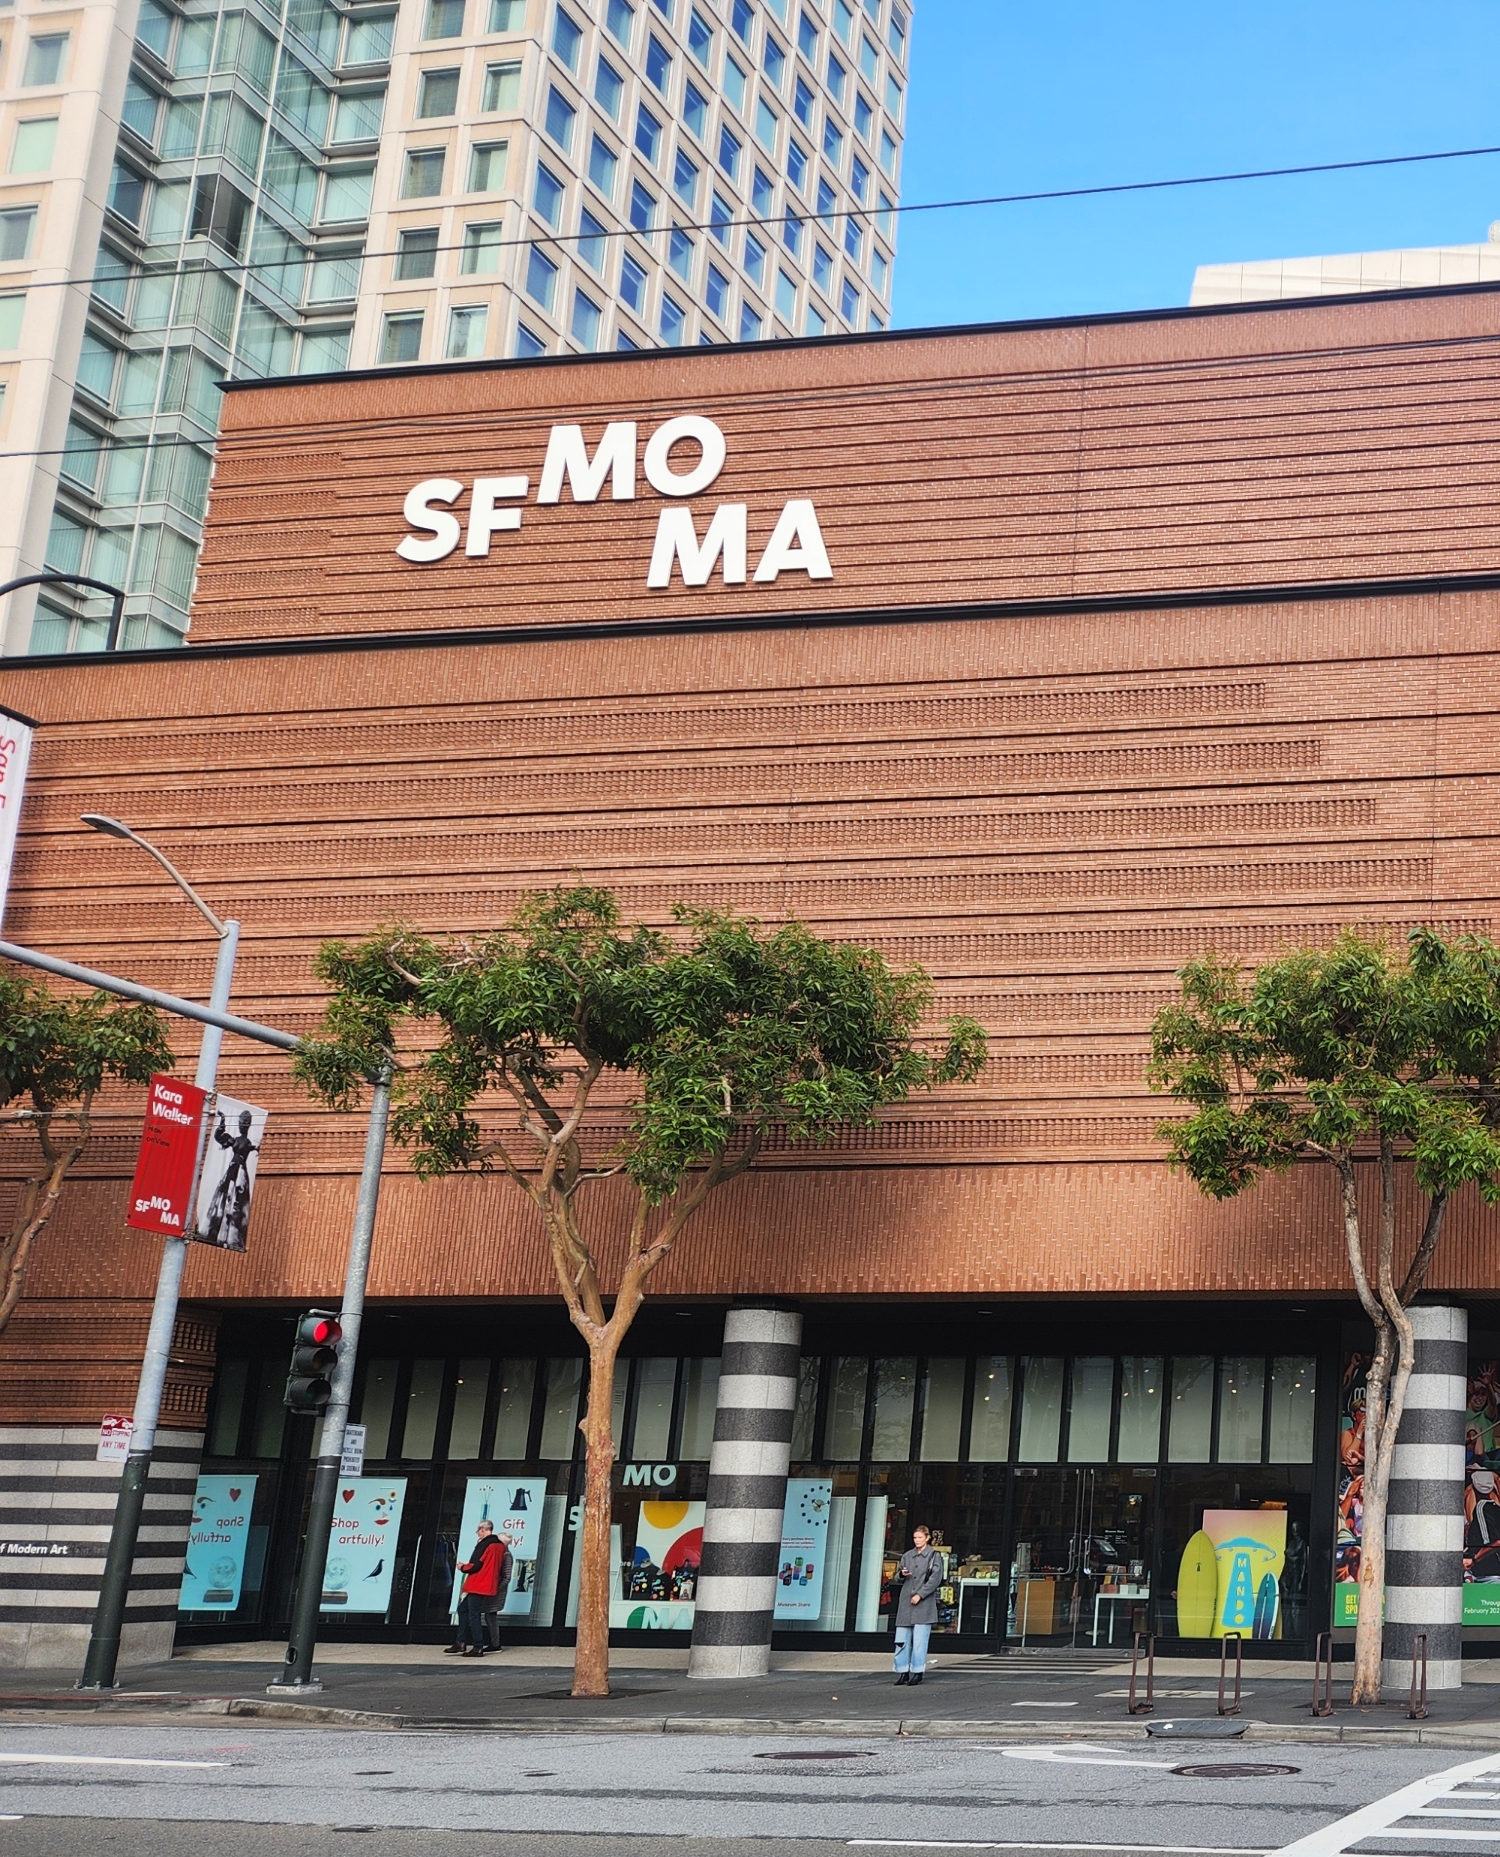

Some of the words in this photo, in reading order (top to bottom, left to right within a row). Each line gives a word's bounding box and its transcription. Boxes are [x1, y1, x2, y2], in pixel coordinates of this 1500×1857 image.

[395, 477, 530, 563] SF
[536, 415, 727, 504] MO
[646, 499, 834, 588] MA
[154, 1083, 183, 1105] Kara
[152, 1101, 194, 1126] Walker
[134, 1198, 151, 1213] SF
[150, 1195, 171, 1211] MO
[160, 1211, 180, 1226] MA
[102, 1428, 112, 1436] NO
[102, 1441, 112, 1449] ANY
[113, 1441, 127, 1450] TIME
[622, 1464, 677, 1487] MO
[331, 1517, 360, 1530] Shop
[502, 1518, 526, 1530] Gift
[338, 1534, 385, 1547] artfully!
[0, 1543, 7, 1554] f
[7, 1543, 48, 1554] Modern
[50, 1544, 68, 1555] Art
[1233, 1557, 1247, 1625] MANDO
[641, 1607, 692, 1629] MA
[1463, 1607, 1489, 1615] February
